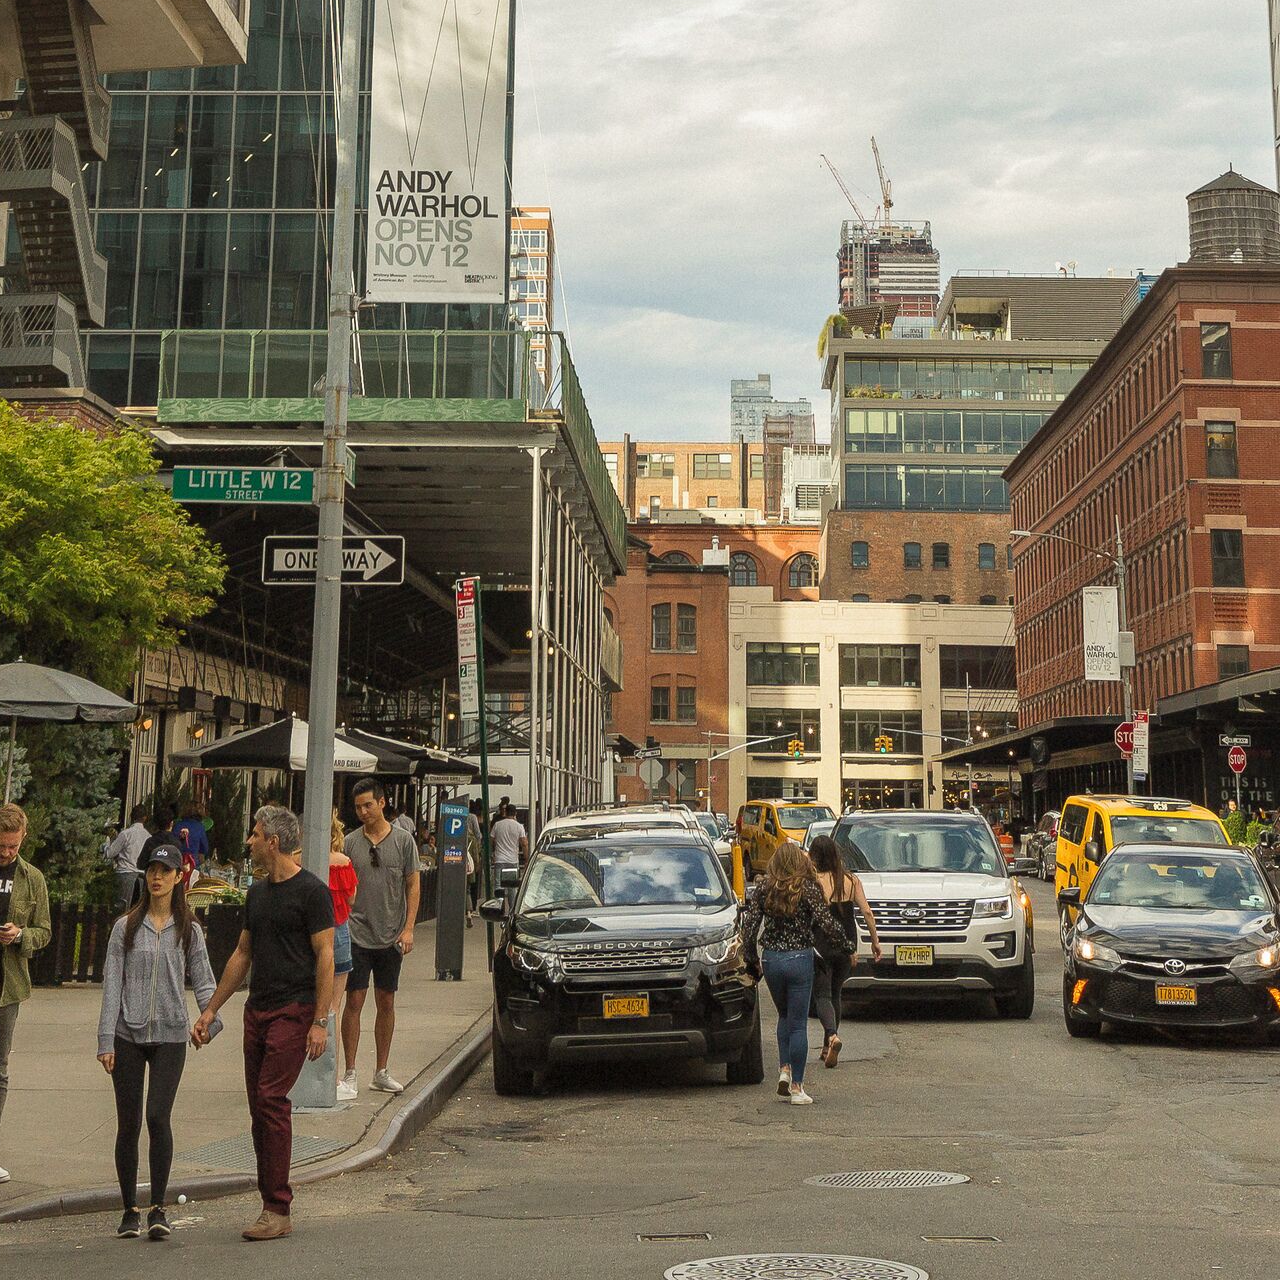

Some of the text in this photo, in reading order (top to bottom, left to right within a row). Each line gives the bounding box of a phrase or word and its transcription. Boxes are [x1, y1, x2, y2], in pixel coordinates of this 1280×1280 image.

[375, 170, 454, 194] ANDY
[375, 194, 499, 219] WARHOL
[374, 218, 473, 243] OPENS
[374, 243, 469, 268] NOV 12
[188, 470, 302, 490] LITTLE W 12
[225, 489, 264, 500] STREET
[340, 551, 382, 569] WAY
[1086, 651, 1118, 659] WARHOL
[1117, 731, 1133, 744] STO
[346, 760, 361, 768] GRILL
[1229, 754, 1245, 765] STOP
[451, 818, 462, 835] P
[575, 939, 675, 950] DISCOVERY
[1159, 988, 1193, 1001] T781359C
